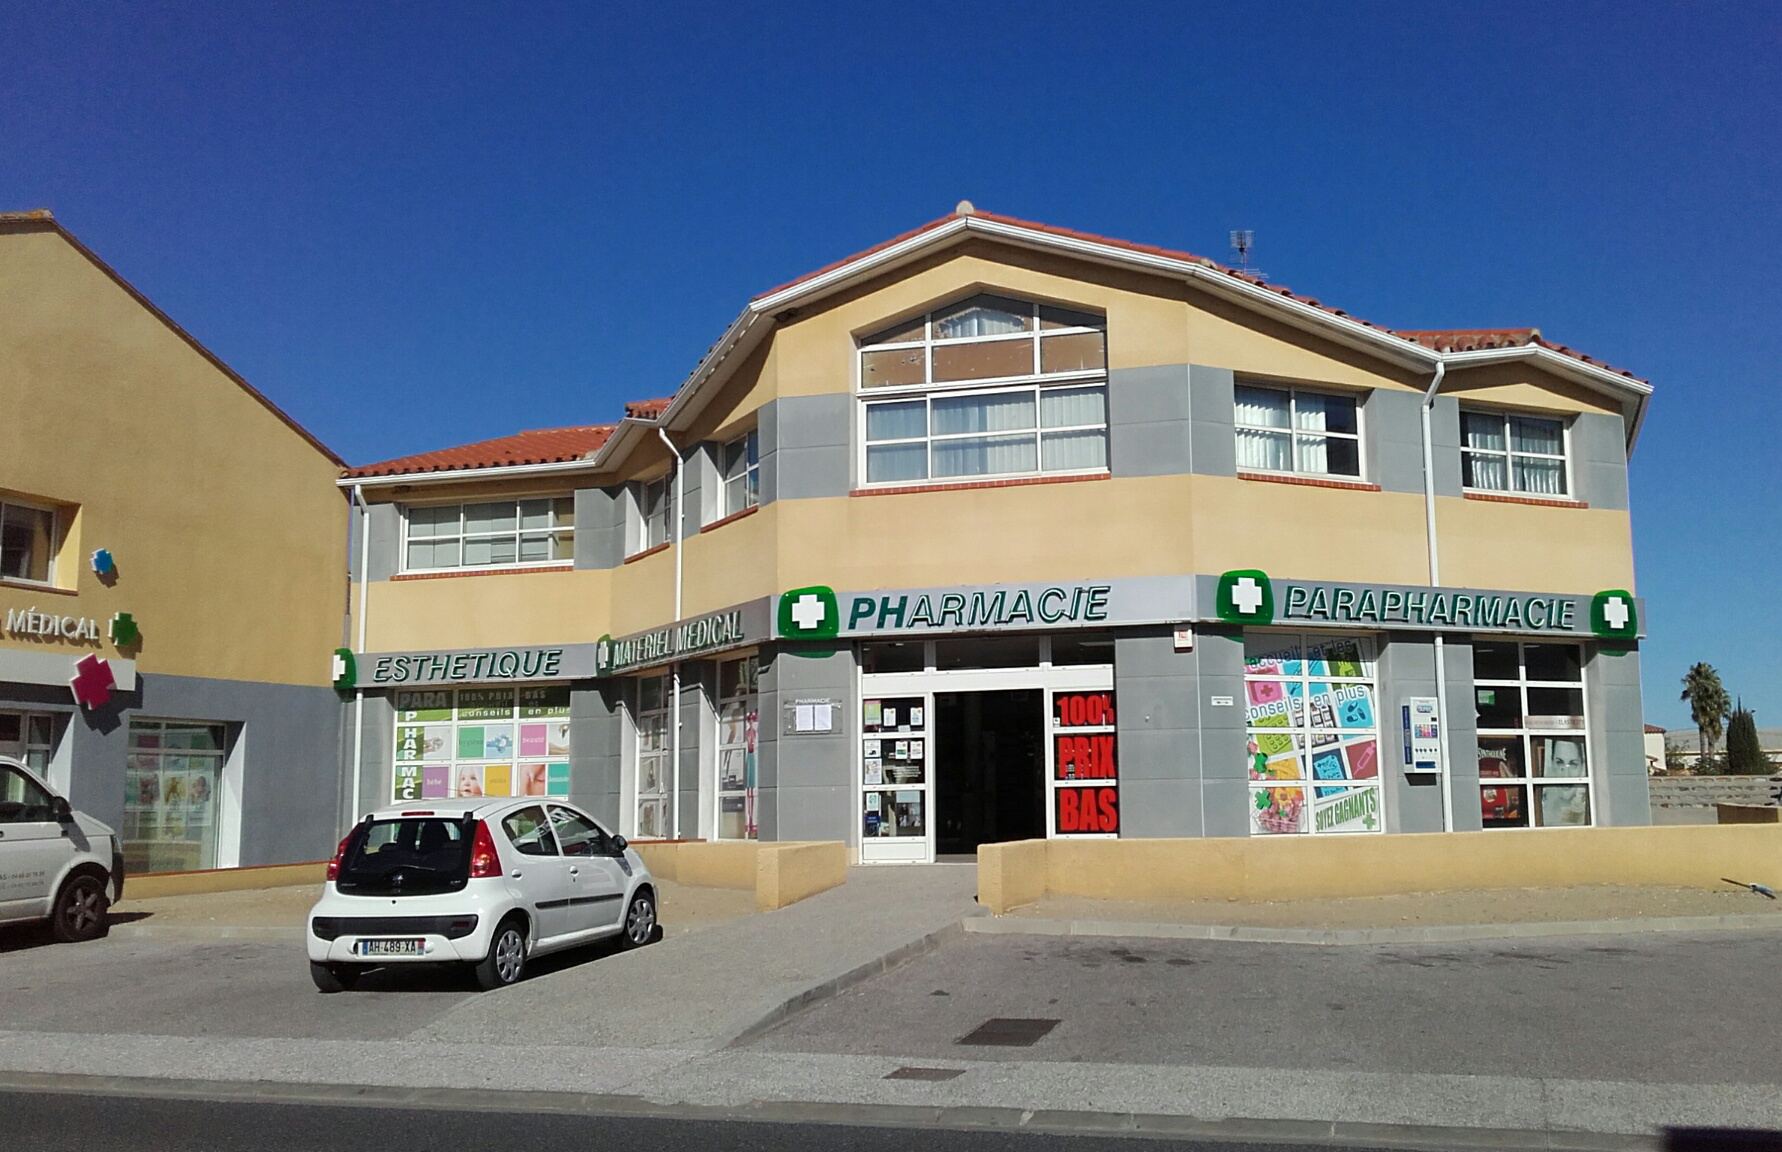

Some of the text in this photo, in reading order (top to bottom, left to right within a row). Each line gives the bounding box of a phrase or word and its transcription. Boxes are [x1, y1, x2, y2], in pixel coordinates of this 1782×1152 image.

[5, 606, 98, 640] MÉDICAL
[848, 586, 1111, 629] PHARMACIE
[1283, 586, 1576, 630] PARAPHARMACIE
[611, 610, 744, 669] MATERIEL MEDICAL
[373, 650, 562, 682] ESTHETIQUE
[400, 692, 447, 708] PARA
[489, 691, 514, 700] PRIX
[1057, 694, 1115, 726] 100%
[1314, 694, 1330, 706] en
[1336, 685, 1365, 707] plus
[461, 710, 511, 718] conseils
[1058, 735, 1116, 778] PRIX
[1060, 787, 1117, 832] BAS
[1315, 787, 1376, 832] SOYEZ GAGNANTS
[368, 940, 416, 953] AH-489-XA
